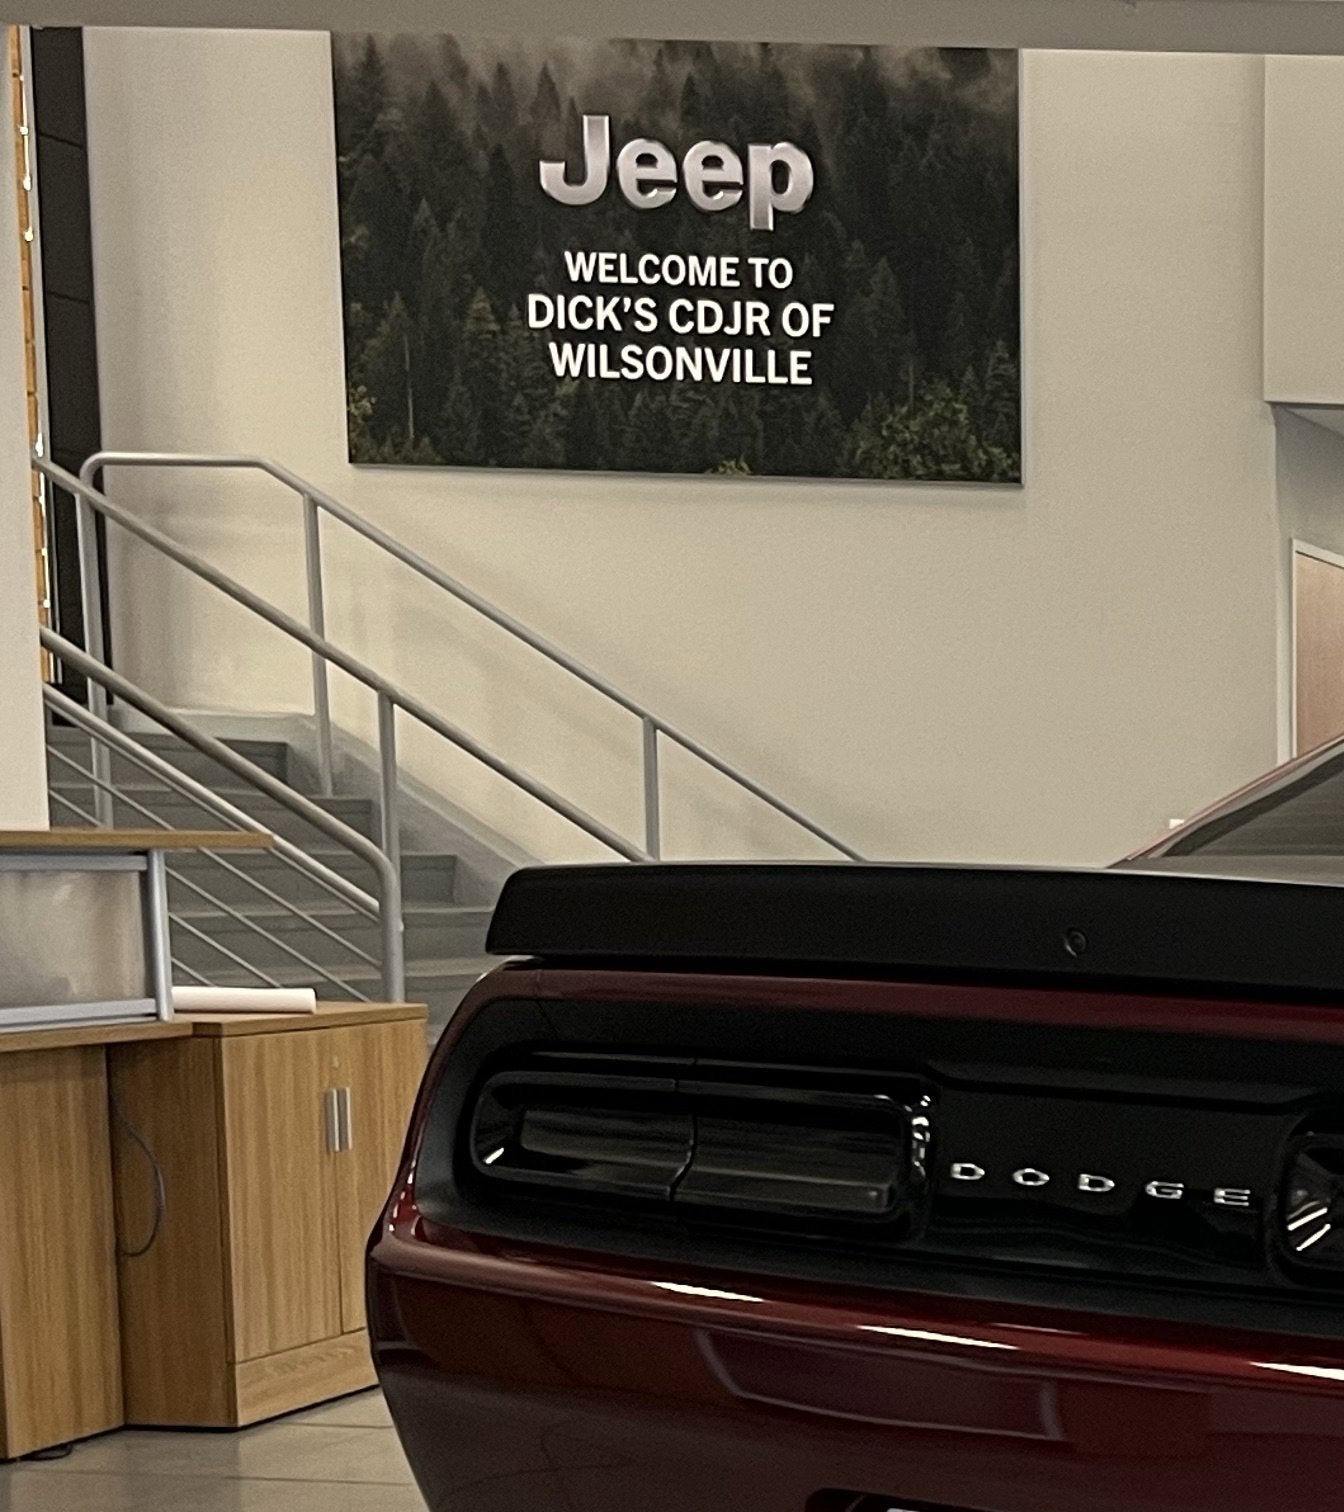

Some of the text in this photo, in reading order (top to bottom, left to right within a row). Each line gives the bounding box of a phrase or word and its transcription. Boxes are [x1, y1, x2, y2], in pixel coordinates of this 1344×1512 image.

[540, 114, 814, 231] Jeep
[564, 250, 793, 289] WELCOME TO
[528, 293, 835, 338] DICK'S CDJR OF
[549, 342, 813, 385] WILSONVILLE
[951, 1163, 1250, 1206] DODGE
